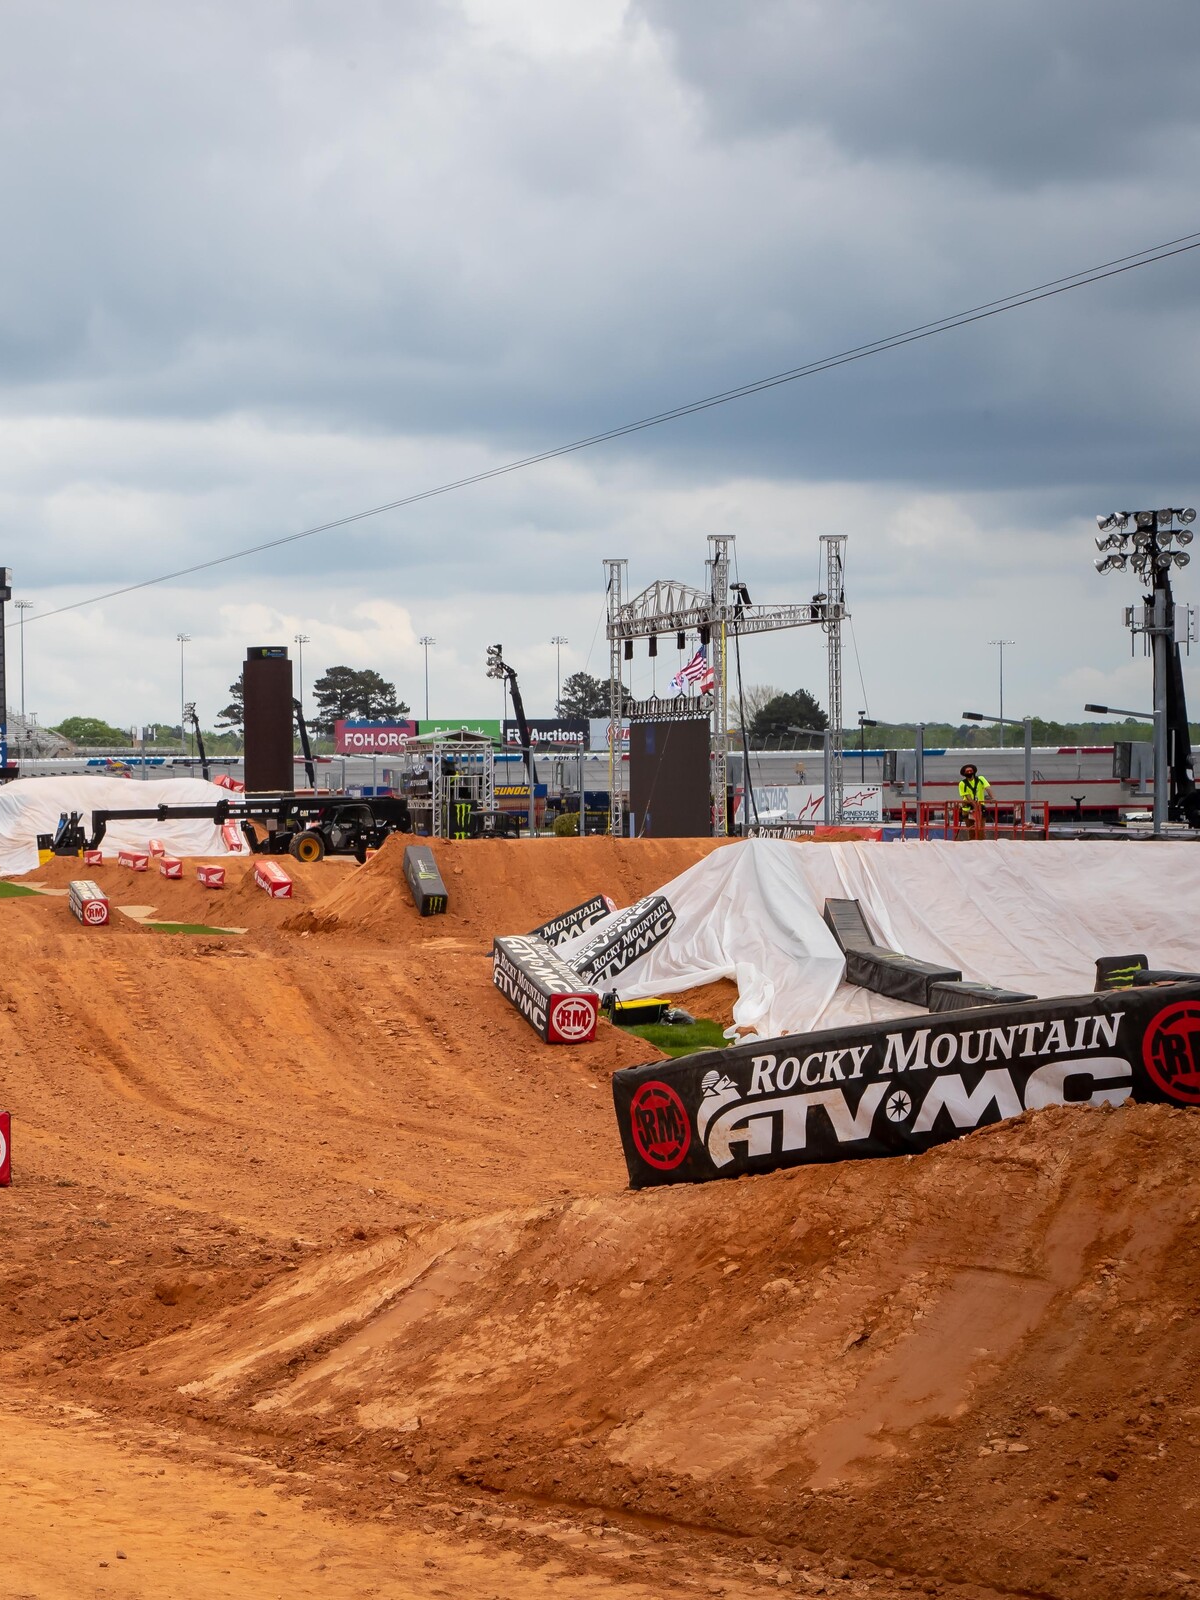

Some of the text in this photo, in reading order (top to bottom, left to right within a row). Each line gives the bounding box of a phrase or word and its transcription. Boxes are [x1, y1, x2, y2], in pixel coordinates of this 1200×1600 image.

[344, 733, 409, 746] FOH.ORG
[506, 728, 584, 744] FRAuctions
[543, 898, 602, 938] MOUNTAIN
[592, 900, 668, 972] ROCKY MOUNTAIN
[501, 952, 548, 1011] ROCKY MOUNTAIN
[560, 1010, 587, 1027] RM
[747, 1011, 1126, 1096] ROCKY MOUNTAIN
[640, 1107, 684, 1144] RM
